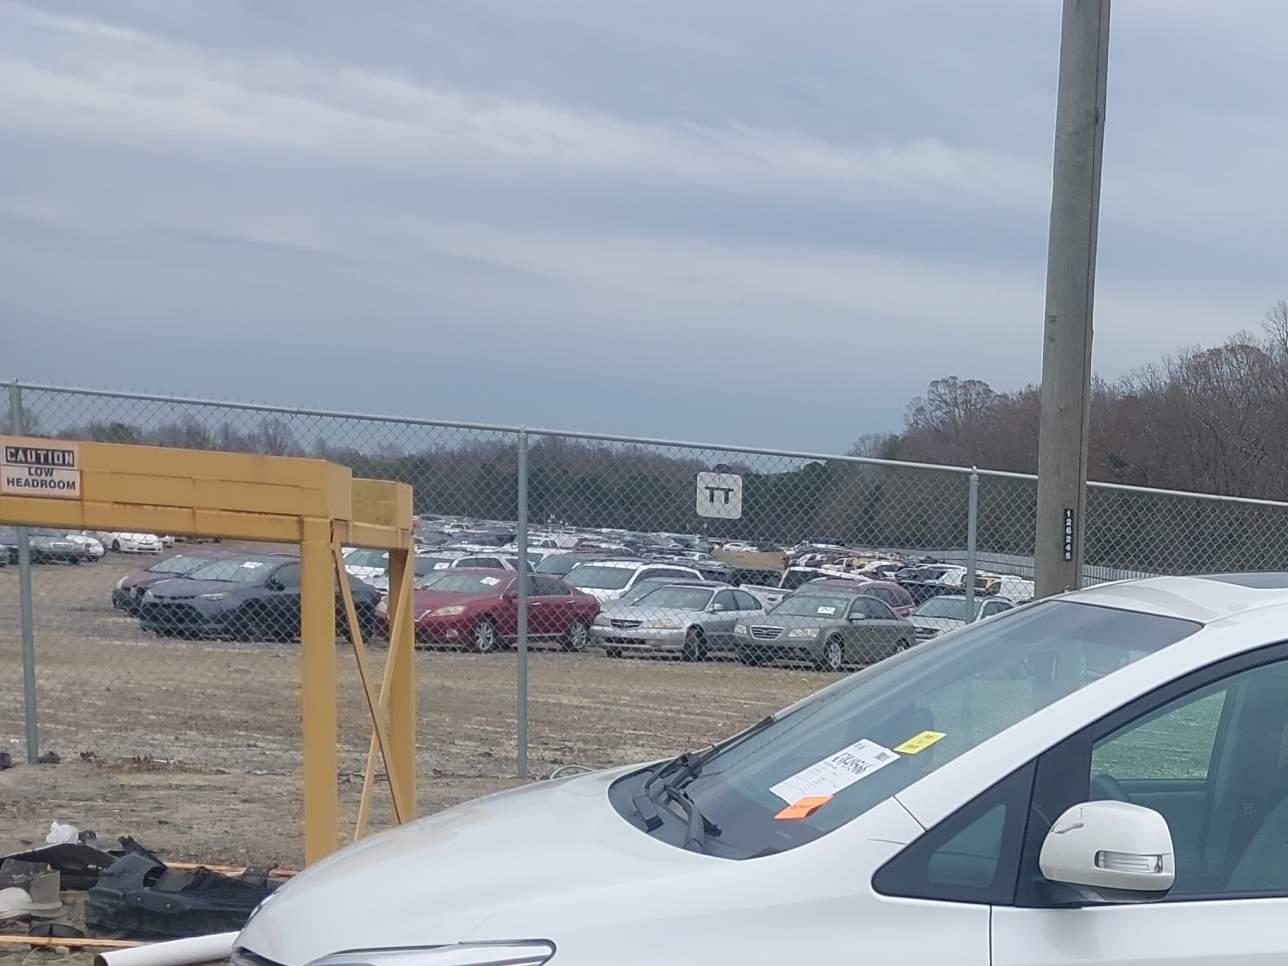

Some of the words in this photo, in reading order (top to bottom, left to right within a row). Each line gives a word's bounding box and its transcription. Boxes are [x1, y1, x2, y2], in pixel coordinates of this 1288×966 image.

[6, 448, 74, 465] CAUTION
[27, 467, 54, 477] LOW
[7, 477, 76, 491] HEADROOM
[704, 486, 734, 505] TT
